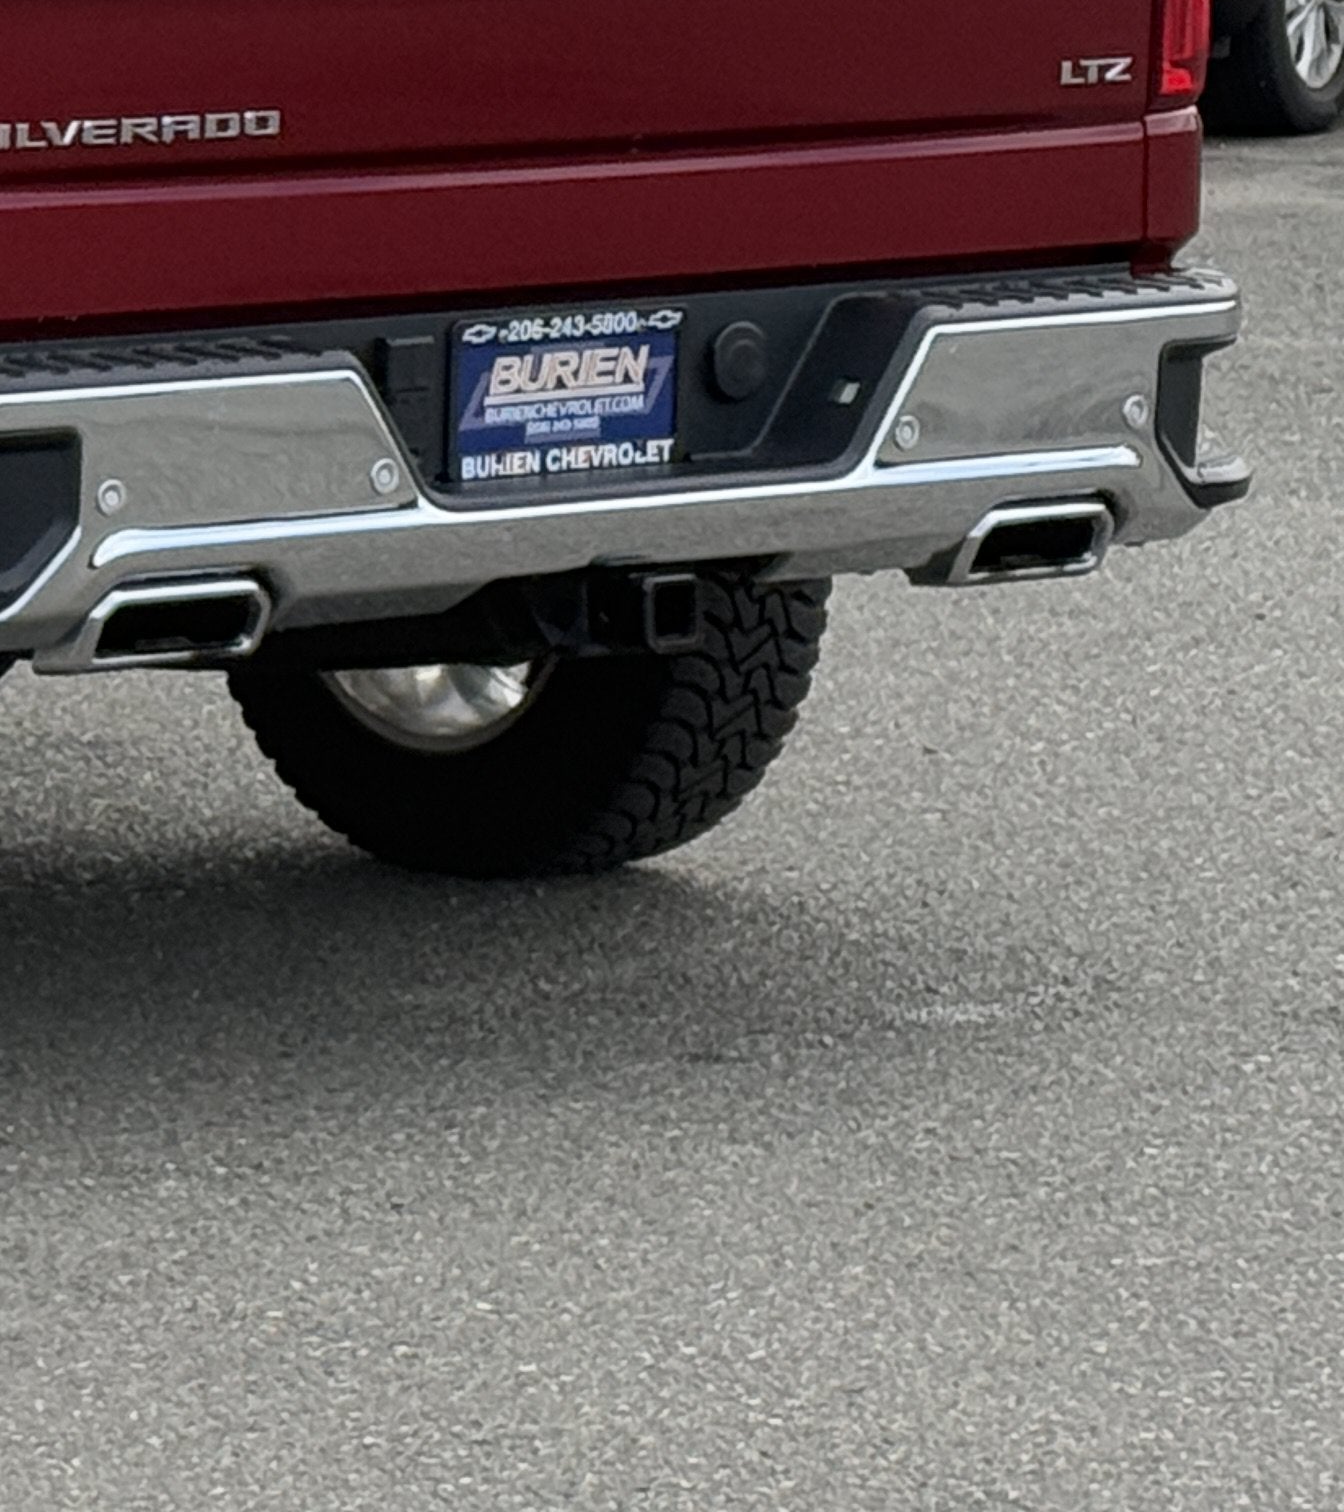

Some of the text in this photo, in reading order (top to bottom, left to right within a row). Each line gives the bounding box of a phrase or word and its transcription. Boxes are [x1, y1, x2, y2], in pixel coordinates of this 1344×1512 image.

[1060, 57, 1133, 85] LTZ
[489, 344, 650, 395] BURIEN
[545, 439, 675, 472] CHEVROLET
